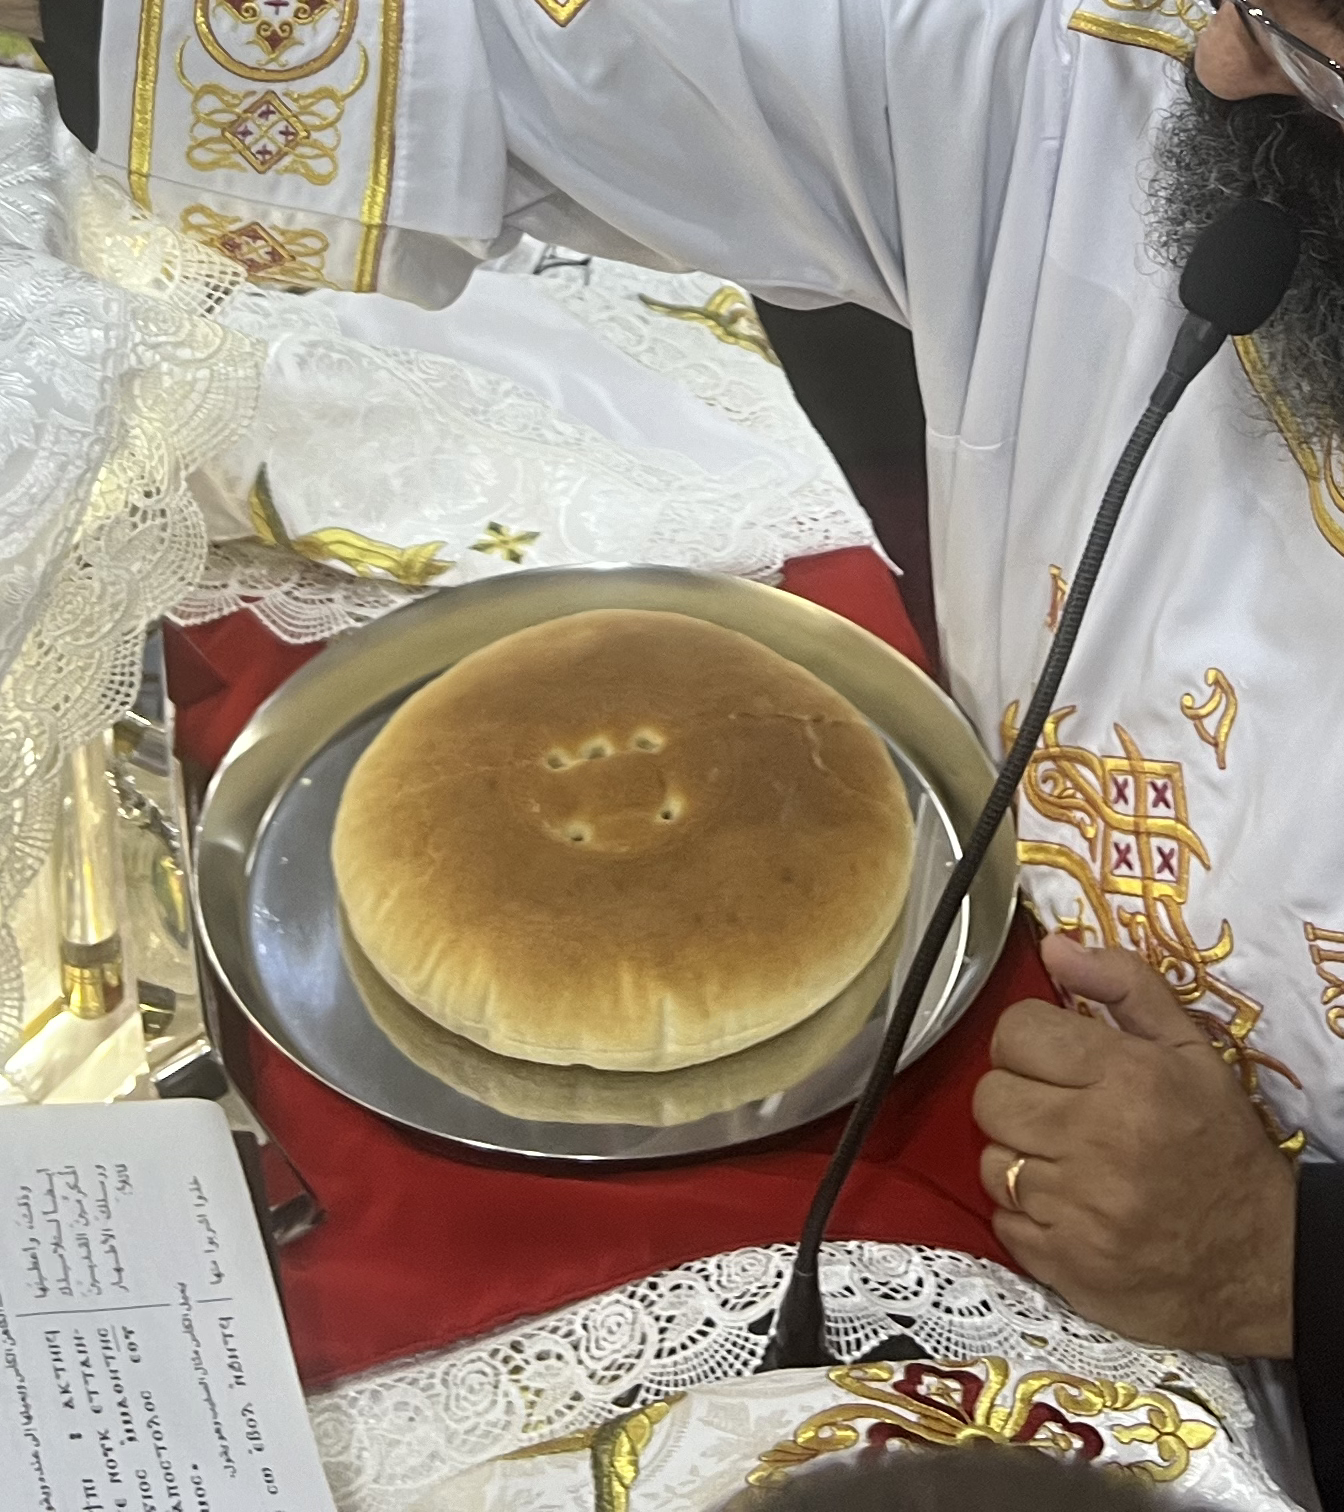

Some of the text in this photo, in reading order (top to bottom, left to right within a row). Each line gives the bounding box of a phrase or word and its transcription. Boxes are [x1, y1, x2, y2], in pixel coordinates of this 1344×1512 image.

[188, 1175, 209, 1208] خذوا
[208, 1259, 226, 1286] منها
[176, 1281, 192, 1312] يميل
[190, 1349, 209, 1376] مثال
[197, 1377, 219, 1420] الصليب
